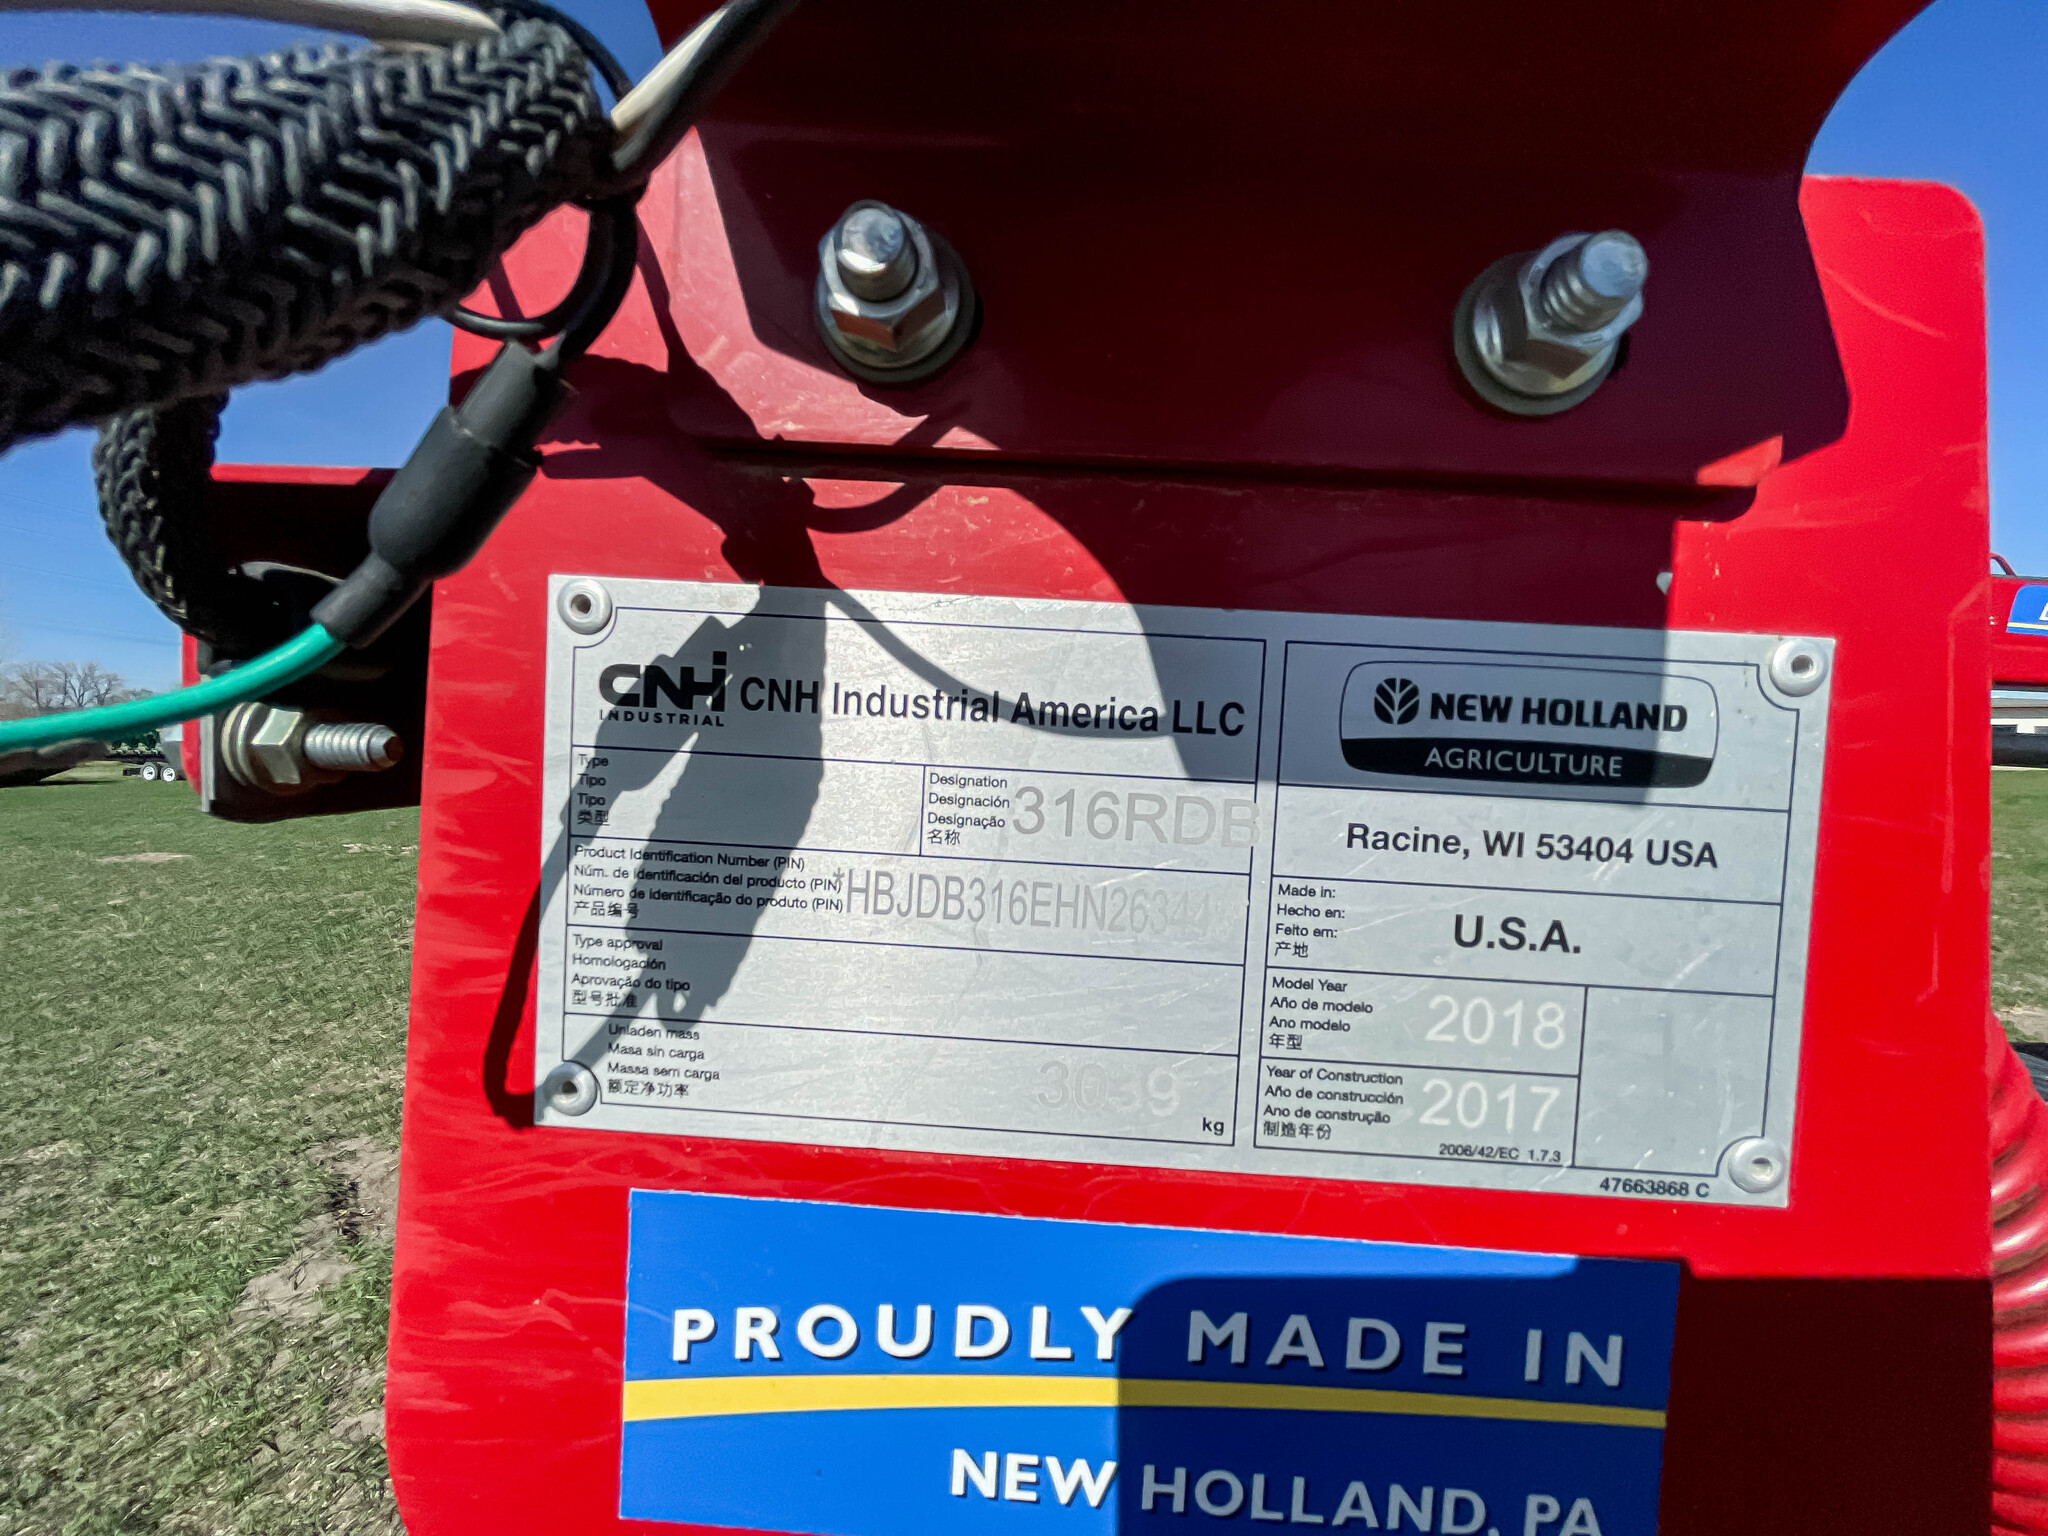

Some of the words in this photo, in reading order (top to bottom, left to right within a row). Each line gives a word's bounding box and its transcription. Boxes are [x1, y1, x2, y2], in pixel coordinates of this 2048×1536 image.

[740, 677, 820, 714] CNH
[832, 682, 1000, 723] Industrial
[1010, 691, 1160, 732] America
[1172, 699, 1245, 737] LLC
[1430, 692, 1514, 723] NEW
[1521, 697, 1688, 732] HOLLAND
[599, 709, 725, 727] INDUSTRIAL
[578, 753, 610, 769] Type
[1424, 746, 1623, 778] AGRICULTURE
[577, 773, 607, 788] Tipo
[929, 772, 1008, 790] Designation
[576, 793, 606, 808] Tipo
[928, 792, 1010, 810] Designación
[576, 810, 610, 827] 类型
[927, 812, 1006, 830] Designação
[1012, 786, 1261, 848] 316RDB
[926, 829, 961, 846] 名称
[1346, 822, 1470, 859] Racine,
[1484, 829, 1525, 857] WI
[1535, 833, 1634, 864] 53404
[1645, 838, 1718, 869] USA
[574, 845, 626, 861] Product
[630, 848, 713, 866] Identification
[717, 854, 769, 868] Number
[773, 856, 805, 871] (PIN)
[574, 864, 608, 878] Núm.
[612, 868, 629, 879] de
[633, 869, 719, 886] identificación
[724, 874, 743, 887] del
[746, 878, 806, 894] producto
[809, 879, 842, 894] (PIN)
[573, 883, 625, 899] Número
[629, 888, 645, 899] de
[650, 889, 731, 908] identificação
[735, 894, 752, 906] do
[756, 897, 808, 913] produto
[812, 896, 844, 912] (PIN)
[1279, 883, 1316, 897] Made
[1320, 886, 1336, 898] in:
[573, 900, 640, 919] 产品编号
[1276, 903, 1321, 918] Hecho
[1325, 908, 1345, 919] en:
[1275, 922, 1309, 936] Feito
[1313, 927, 1338, 939] em:
[1454, 913, 1582, 954] U.S.A.
[572, 934, 603, 948] Type
[607, 938, 663, 953] approval
[1274, 941, 1309, 958] 产地
[571, 953, 666, 971] Homologación
[571, 973, 641, 990] Aprovação
[644, 977, 662, 989] do
[666, 979, 691, 993] tipo
[1272, 976, 1314, 990] Model
[1318, 978, 1348, 992] Year
[571, 989, 638, 1008] 型号批准
[1270, 995, 1298, 1009] Año
[1301, 998, 1319, 1010] de
[1322, 1001, 1374, 1014] modelo
[608, 1023, 661, 1037] Unladen
[666, 1029, 700, 1040] mass
[1269, 1015, 1297, 1029] Ano
[1300, 1019, 1352, 1032] modelo
[1424, 994, 1566, 1050] 2018
[1268, 1032, 1303, 1051] 年型
[607, 1042, 643, 1055] Masa
[646, 1046, 665, 1058] sin
[668, 1049, 705, 1062] carga
[607, 1062, 649, 1076] Massa
[653, 1067, 680, 1078] sem
[684, 1069, 720, 1083] carga
[1266, 1065, 1296, 1079] Year
[1299, 1068, 1313, 1080] of
[1316, 1068, 1403, 1085] Construction
[1264, 1085, 1292, 1098] Año
[1295, 1087, 1313, 1099] de
[1316, 1090, 1404, 1105] construcción
[1263, 1104, 1291, 1117] Ano
[1294, 1106, 1312, 1118] de
[1315, 1109, 1391, 1126] construção
[1419, 1078, 1560, 1133] 2017
[1202, 1117, 1225, 1136] kg
[1263, 1120, 1332, 1140] 制造年份
[1528, 1149, 1561, 1162] 1.7.3
[1599, 1177, 1690, 1197] 47663868
[1695, 1182, 1710, 1198] C
[672, 1304, 1134, 1362] PROUDLY
[1187, 1310, 1467, 1375] MADE
[1524, 1328, 1624, 1386] IN
[950, 1448, 1118, 1508] NEW
[1523, 1494, 1602, 1536] PA
